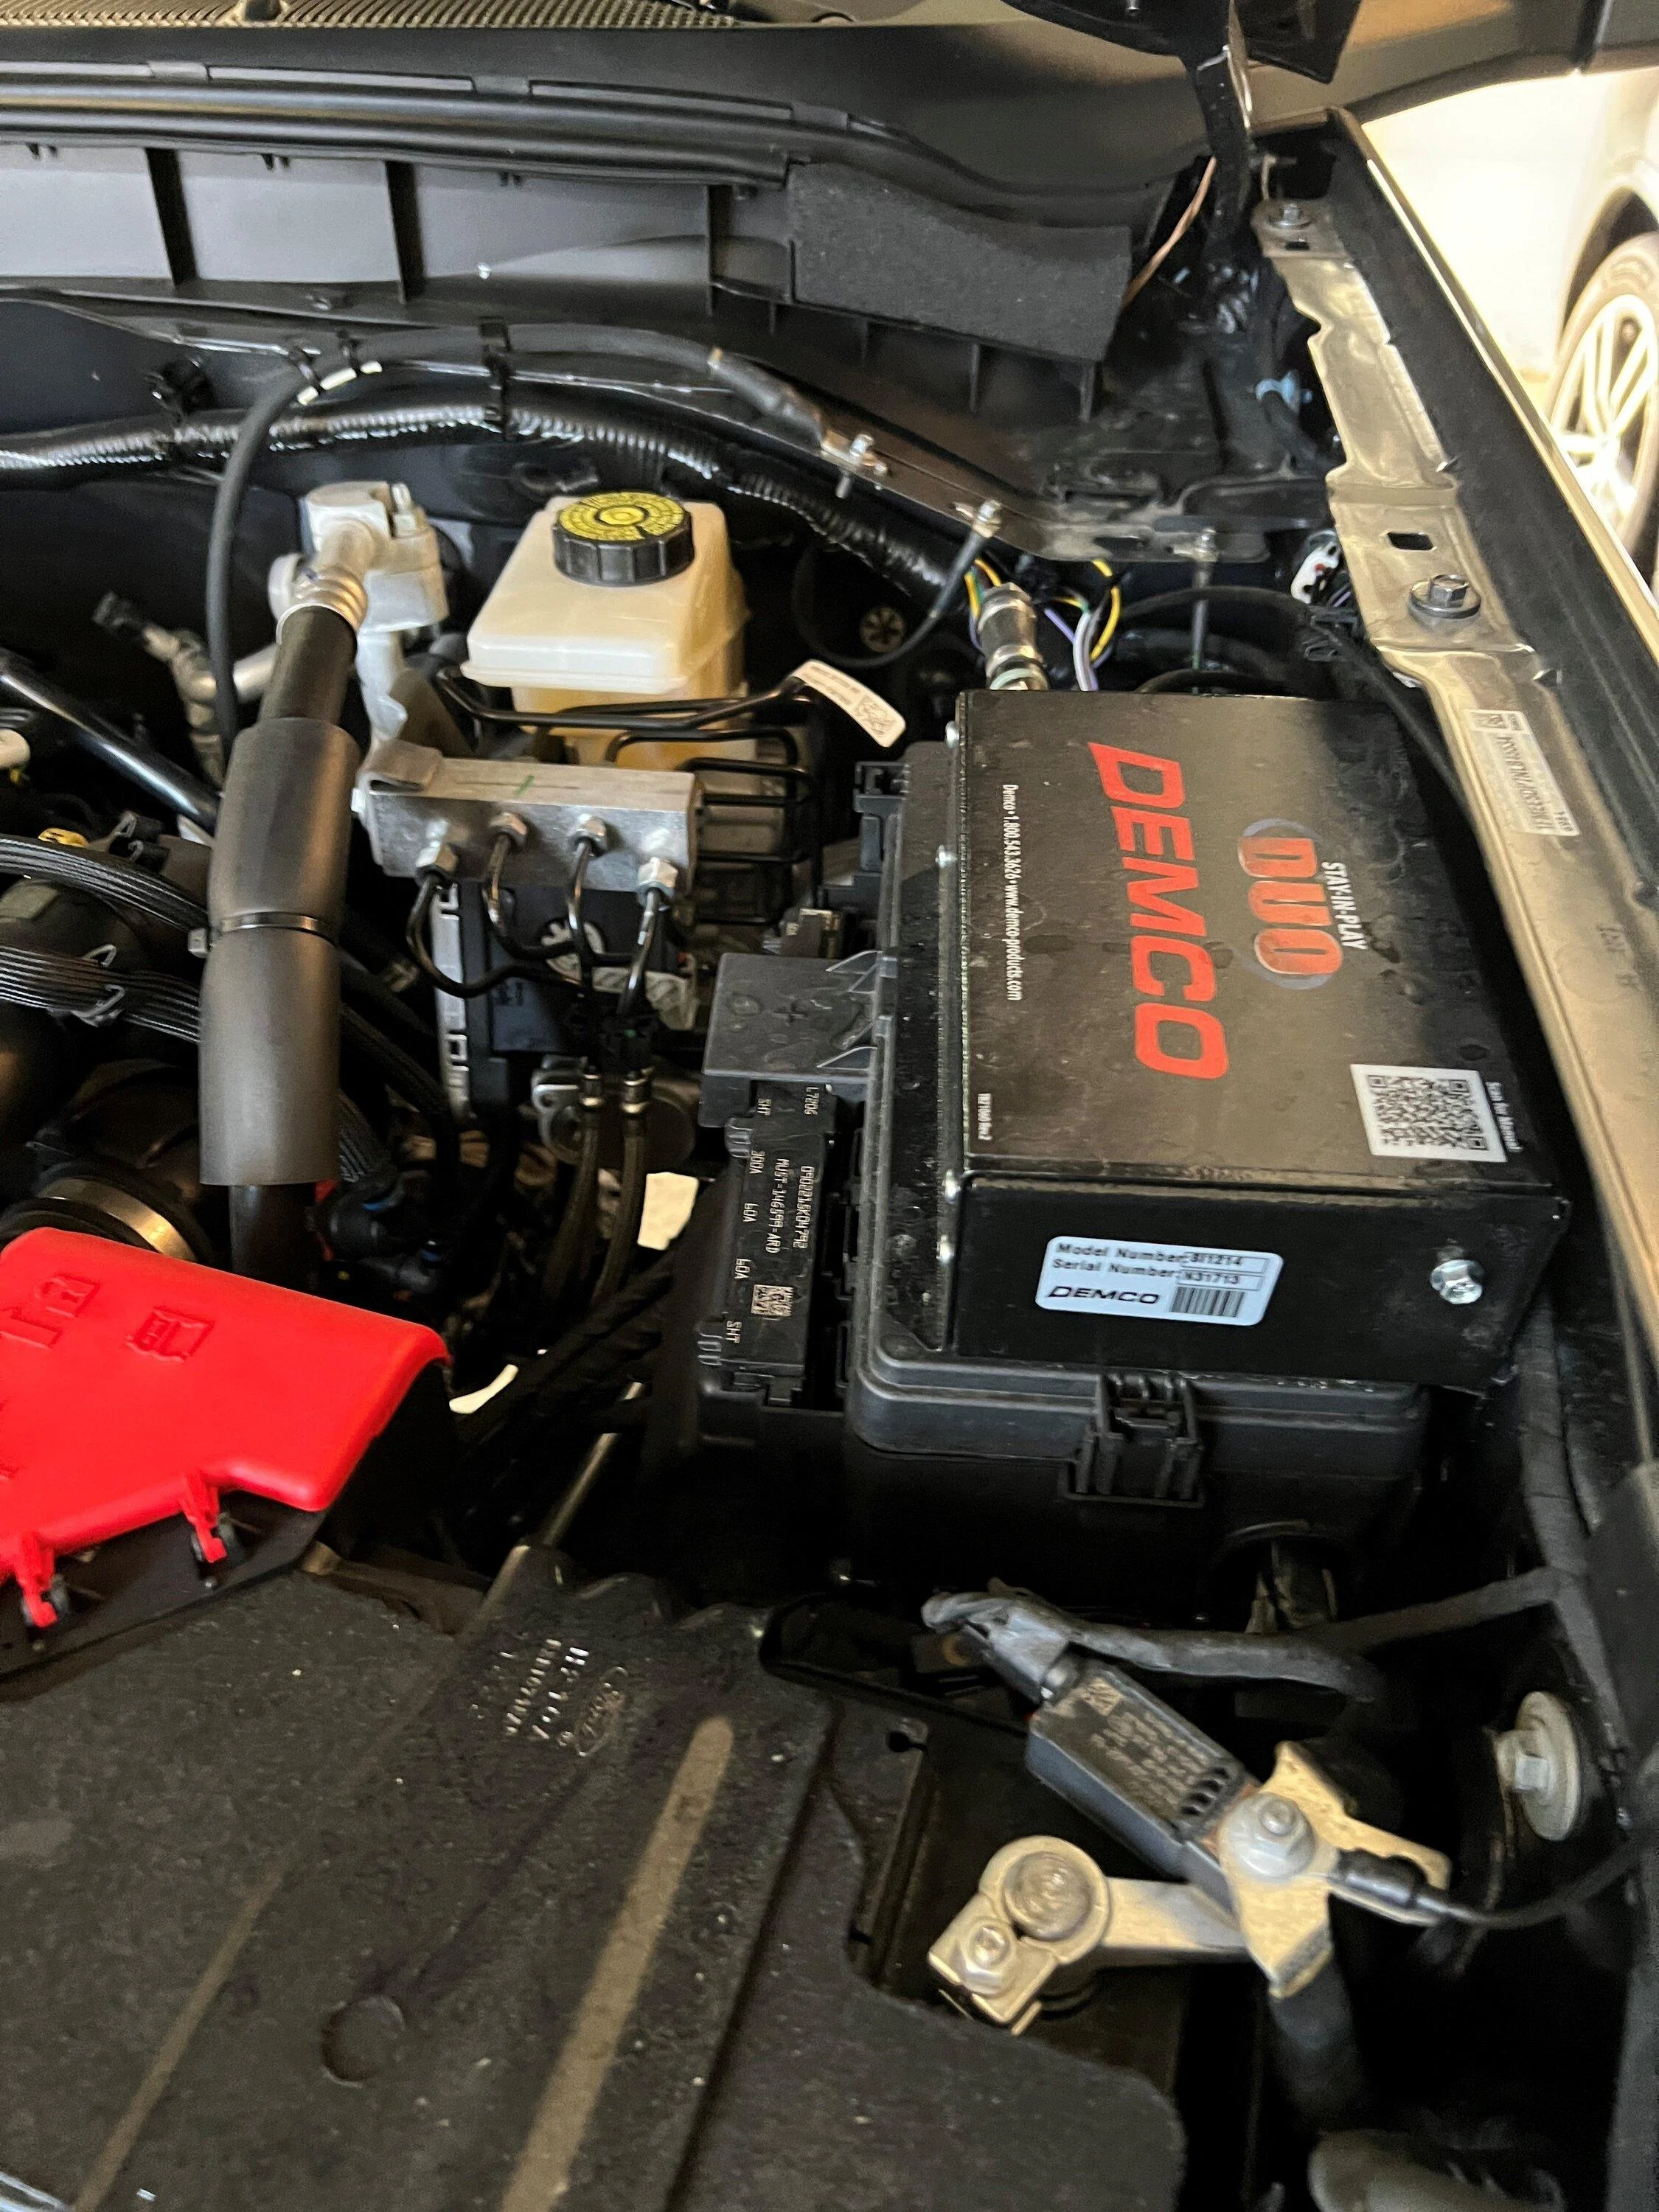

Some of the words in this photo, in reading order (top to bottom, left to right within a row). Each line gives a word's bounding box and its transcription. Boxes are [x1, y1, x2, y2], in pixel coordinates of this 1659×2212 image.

[1087, 742, 1230, 1079] DEMCO
[1237, 837, 1344, 975] DUO
[1056, 1243, 1109, 1256] Model
[1052, 1259, 1102, 1272] Serial
[1047, 1285, 1161, 1304] DEMCO
